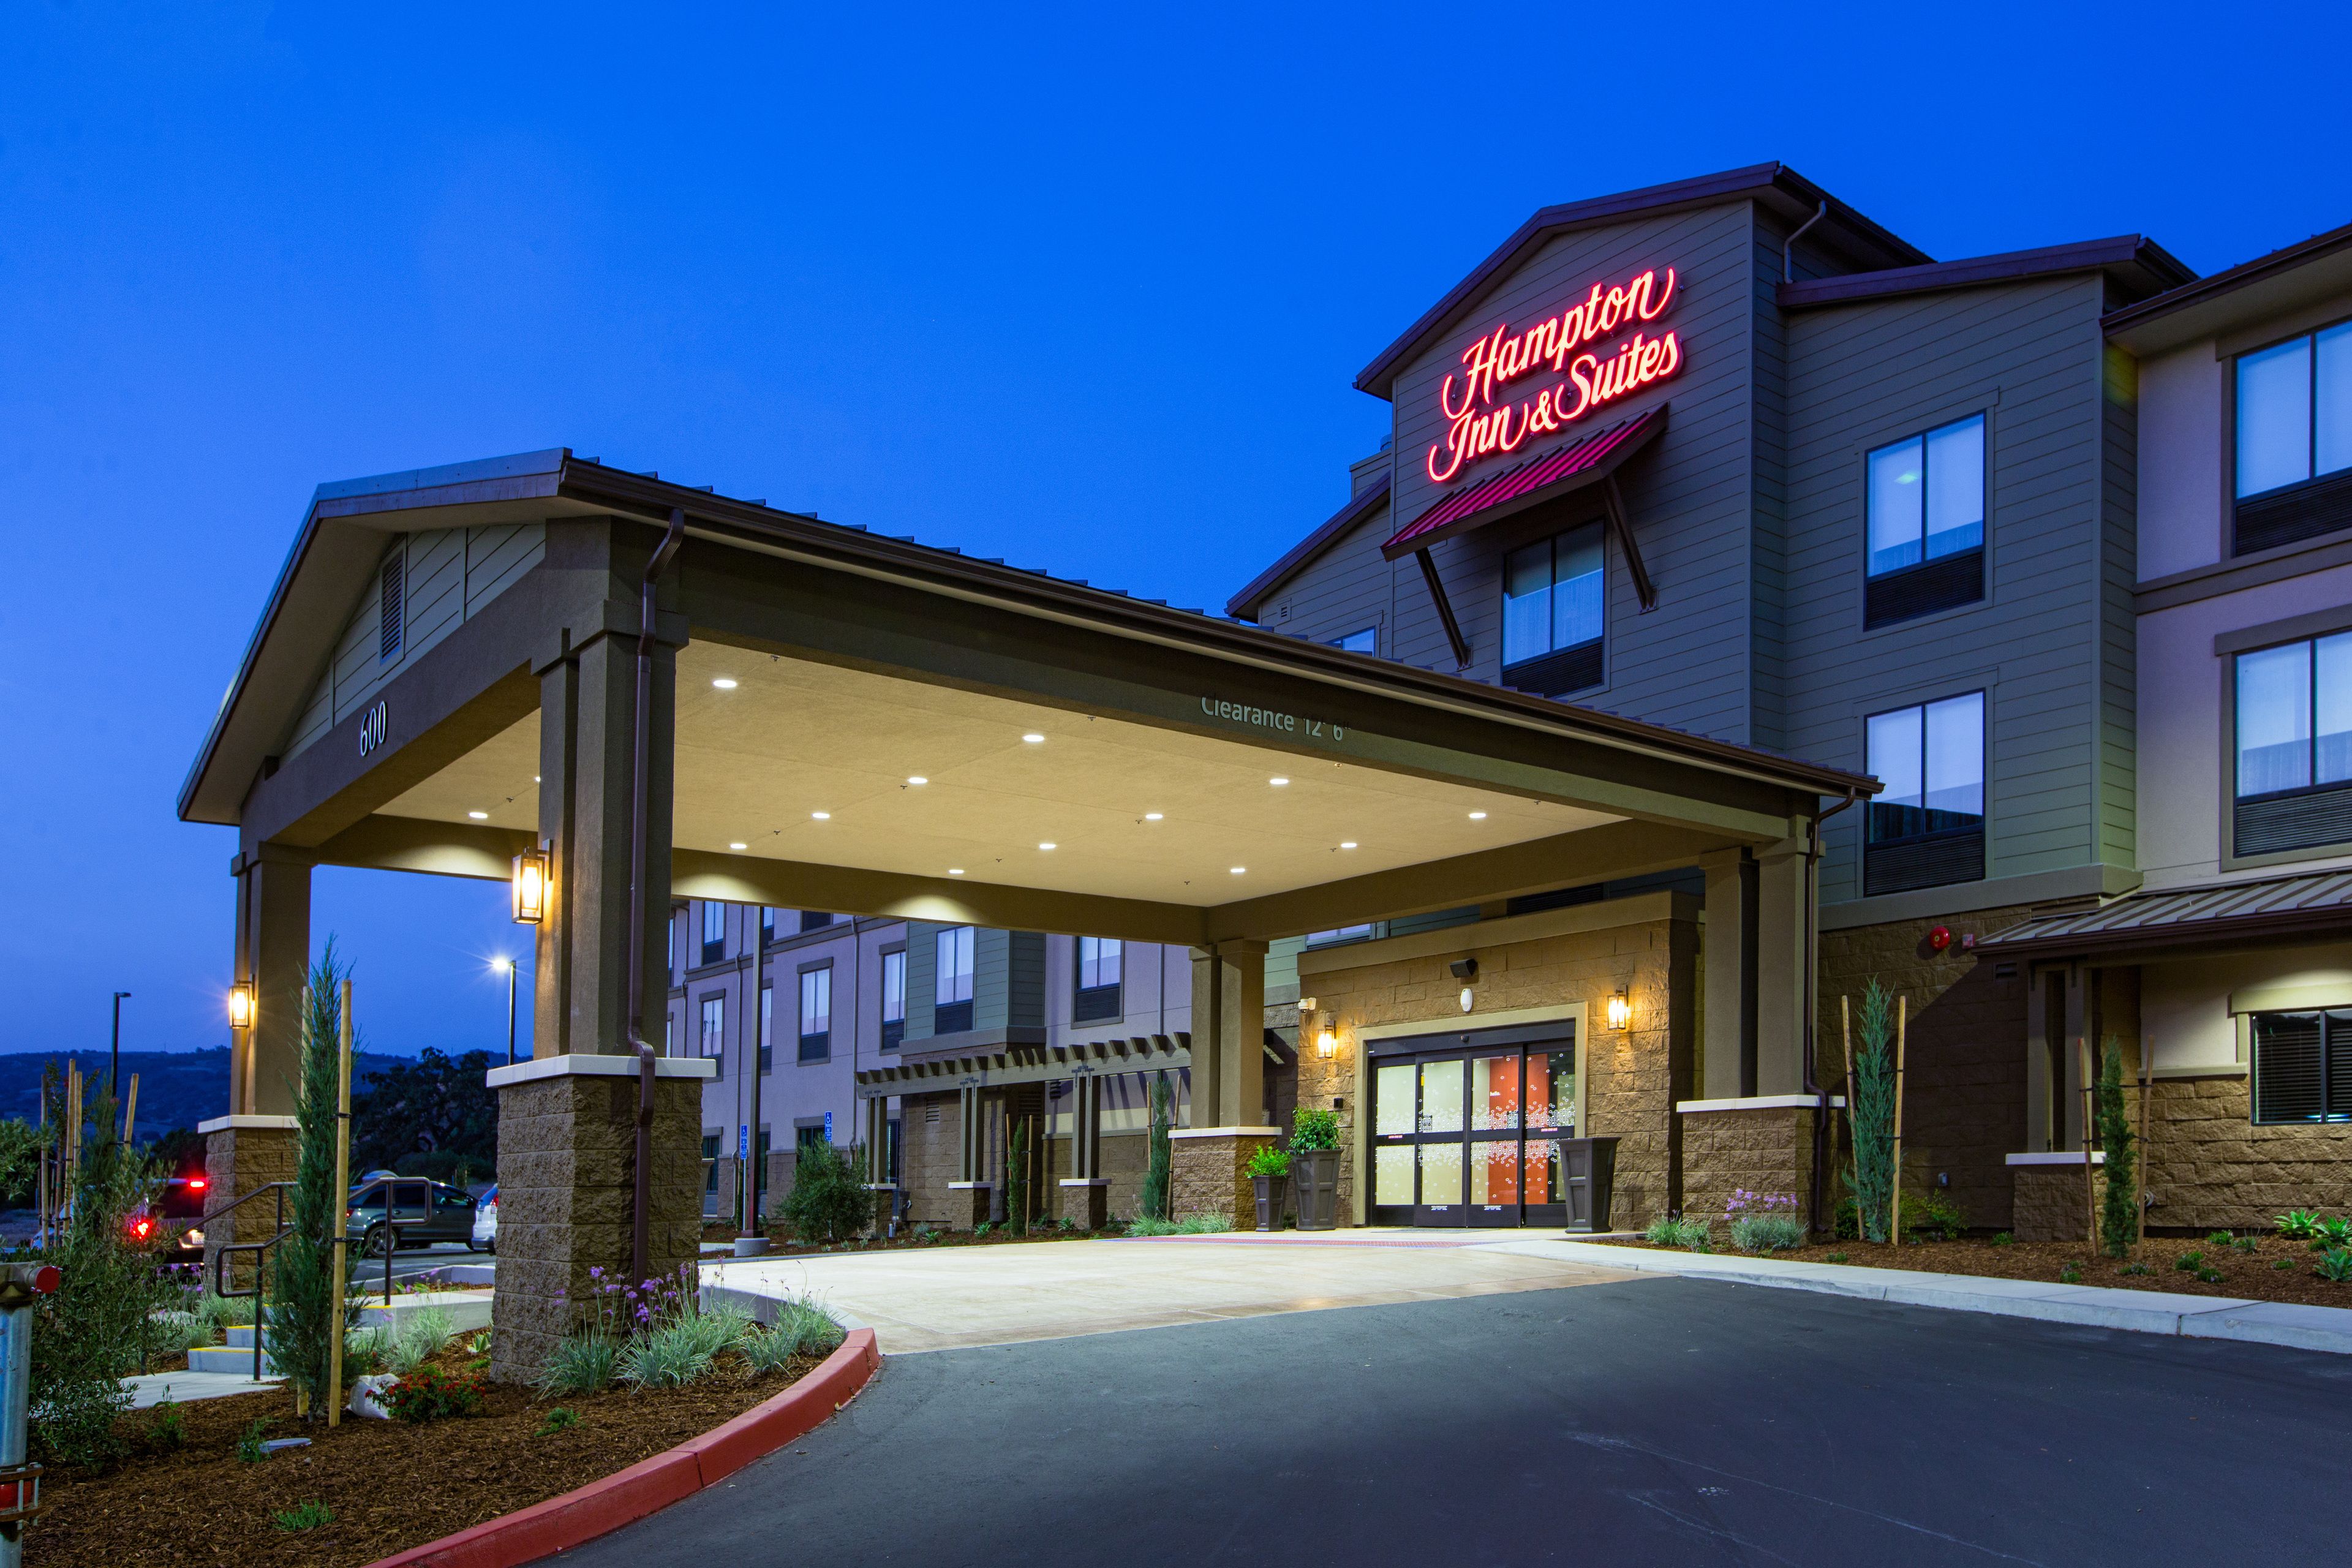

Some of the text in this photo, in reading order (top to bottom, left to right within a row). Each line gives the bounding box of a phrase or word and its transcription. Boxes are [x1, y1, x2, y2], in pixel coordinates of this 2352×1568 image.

[1441, 268, 1675, 420] Hampton
[1428, 331, 1681, 482] Inn & Suites
[360, 701, 386, 756] 600
[1201, 697, 1294, 731] Clearance
[1303, 718, 1325, 737] 12
